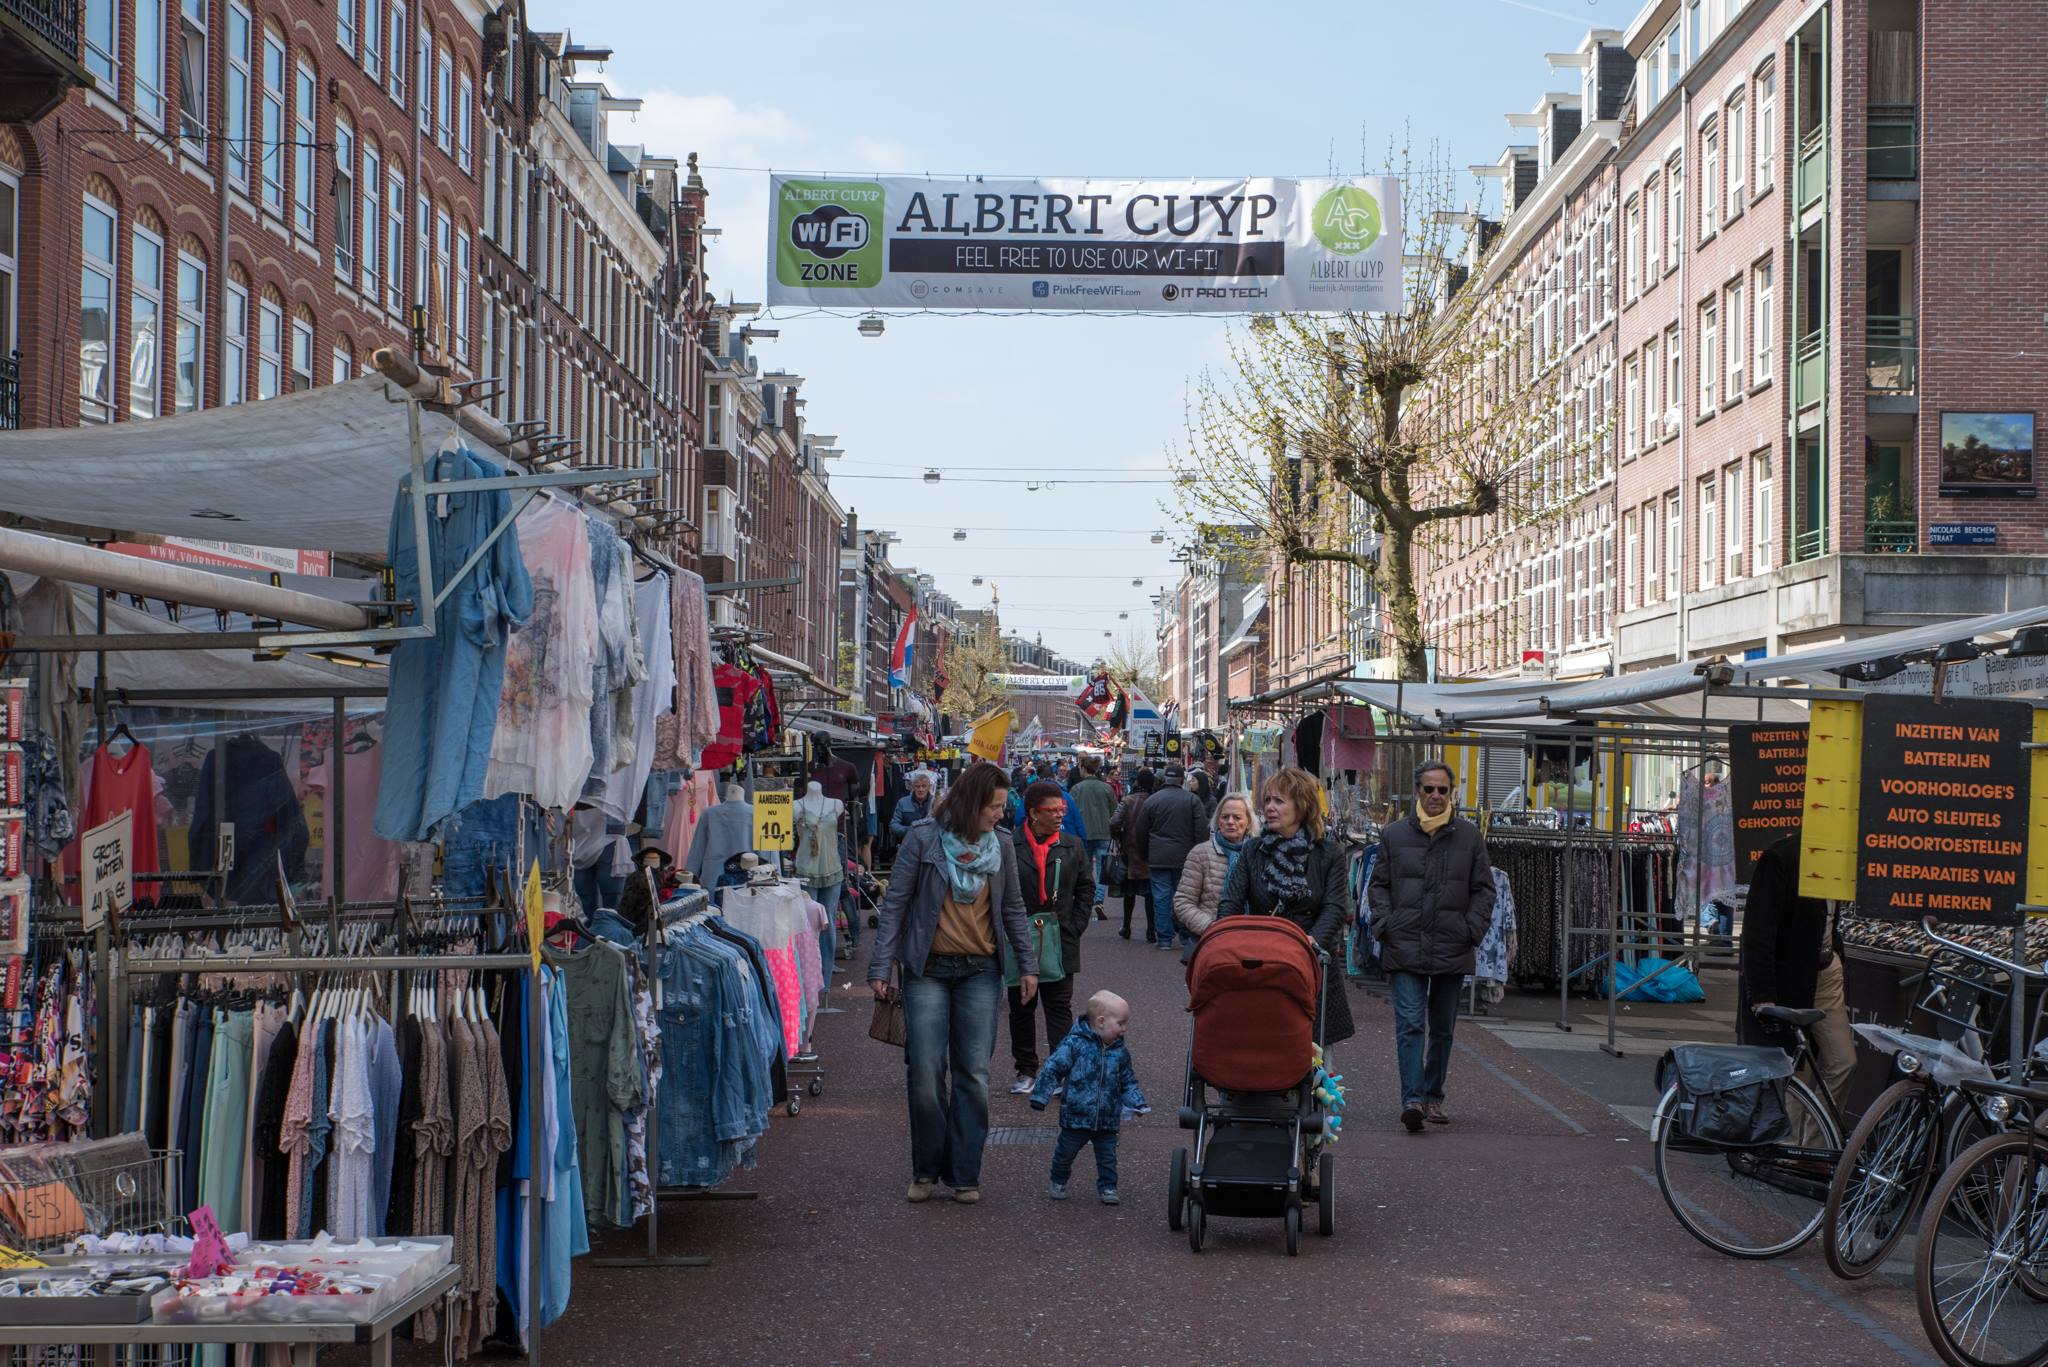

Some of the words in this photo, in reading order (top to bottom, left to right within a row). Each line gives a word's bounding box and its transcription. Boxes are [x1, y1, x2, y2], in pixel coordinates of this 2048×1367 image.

[785, 188, 838, 201] ALBERT
[840, 189, 880, 202] CUYP
[896, 191, 1112, 236] ALBERT
[1125, 194, 1277, 237] CUYP
[956, 246, 995, 267] FEEL
[1000, 246, 1041, 268] FREE
[1046, 247, 1067, 268] TO
[1071, 247, 1107, 269] USE
[1111, 248, 1149, 270] OUR
[1153, 248, 1219, 270] WI-FI!
[800, 263, 858, 281] ZONE
[1310, 260, 1350, 278] ALBERT
[1353, 260, 1385, 278] CUYP
[1052, 284, 1142, 297] PinkFreeWiFi.com
[1181, 287, 1194, 299] IT
[1196, 287, 1227, 299] PRO
[1229, 287, 1268, 299] TECH
[1930, 526, 1961, 534] NICOLAAS
[1964, 526, 1996, 534] BERCHEM
[1930, 534, 1954, 542] STRAAT
[1751, 730, 1799, 743] INZETTEN
[1895, 723, 1964, 741] INZETTEN
[1968, 727, 2000, 743] VAN
[1903, 750, 1991, 769] BATTERIJEN
[1880, 779, 2015, 800] VOORHORLOGE'S
[1752, 799, 1782, 811] AUTO
[1737, 815, 1804, 829] GEHOORTO
[1887, 807, 1930, 824] AUTO
[1933, 810, 2001, 828] SLEUTELS
[92, 838, 121, 863] GROTE
[1865, 833, 2022, 856] GEHOORTOESTELLEN
[95, 850, 124, 884] MATEN
[1867, 862, 1888, 878] EN
[1892, 864, 1980, 883] REPARATIES
[1984, 869, 2016, 886] VAN
[1889, 892, 1924, 908] ALLE
[1928, 894, 1993, 911] MERKEN
